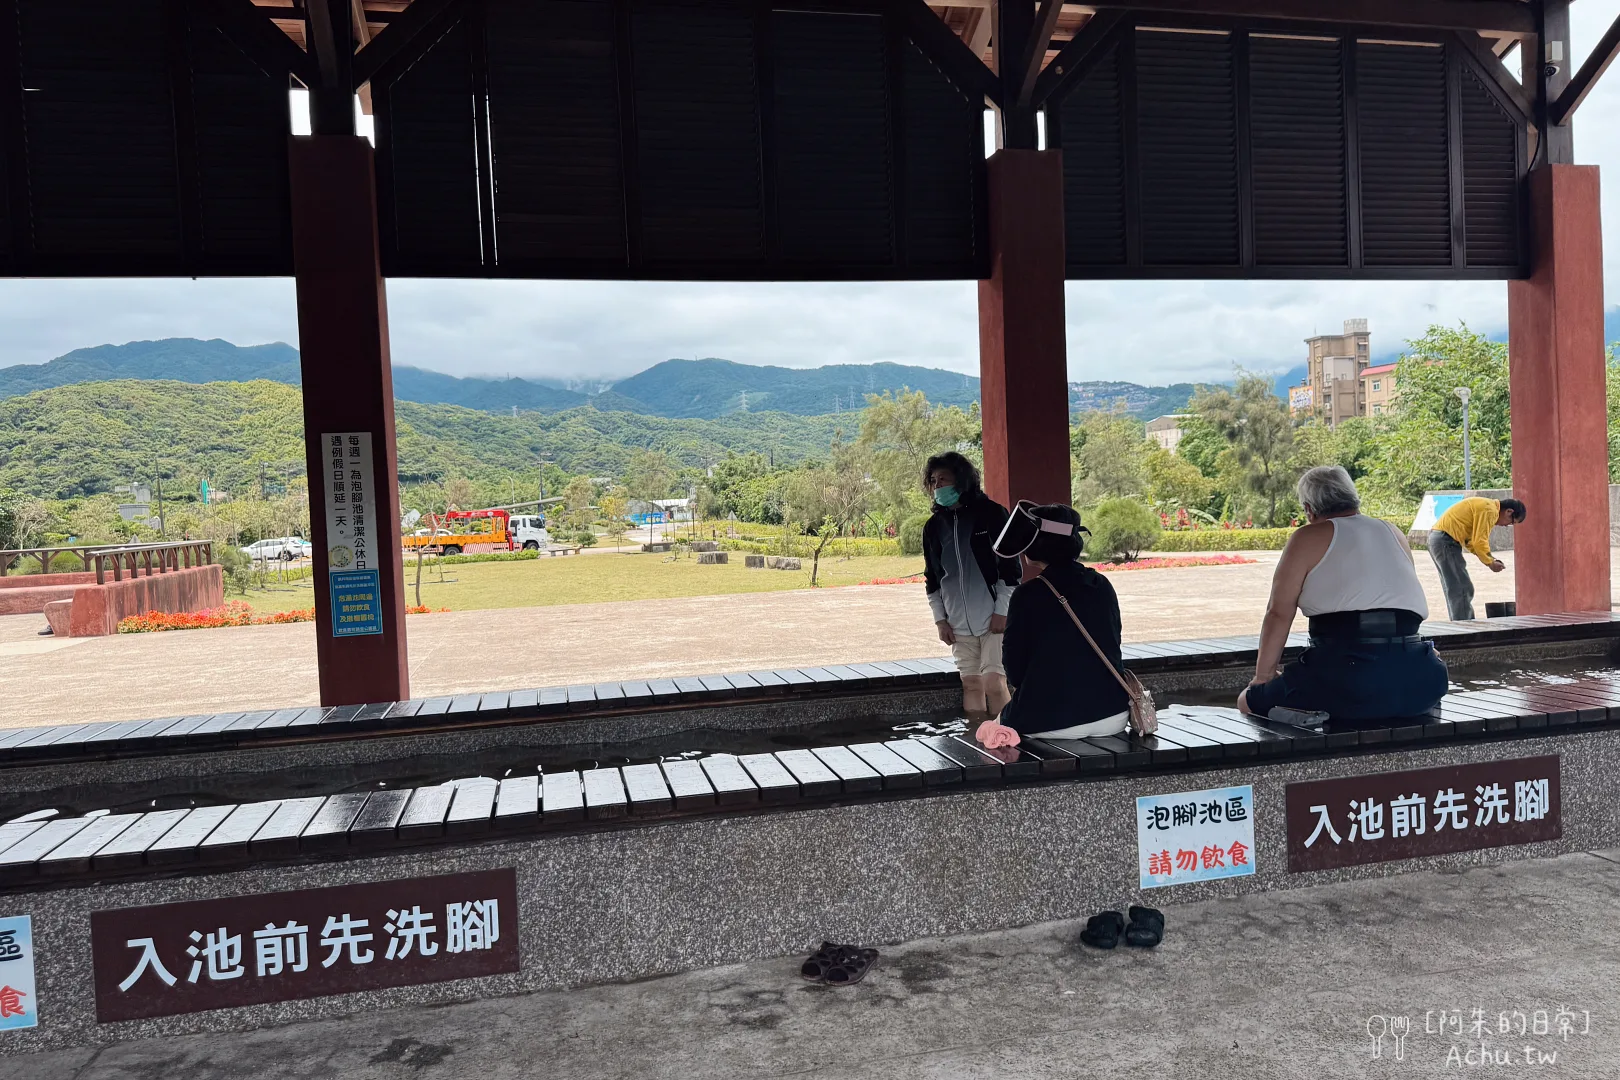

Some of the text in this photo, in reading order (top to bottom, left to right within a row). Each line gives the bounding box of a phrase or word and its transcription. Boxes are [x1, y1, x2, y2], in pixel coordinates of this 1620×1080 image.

[348, 435, 367, 569] 每週一為泡腳池清潔公休日
[1146, 795, 1248, 831] 泡腳池區
[1303, 778, 1550, 849] 入池前先洗腳
[1148, 840, 1250, 876] 請勿飲食
[118, 898, 501, 993] 入池前先洗腳
[0, 985, 27, 1018] 食
